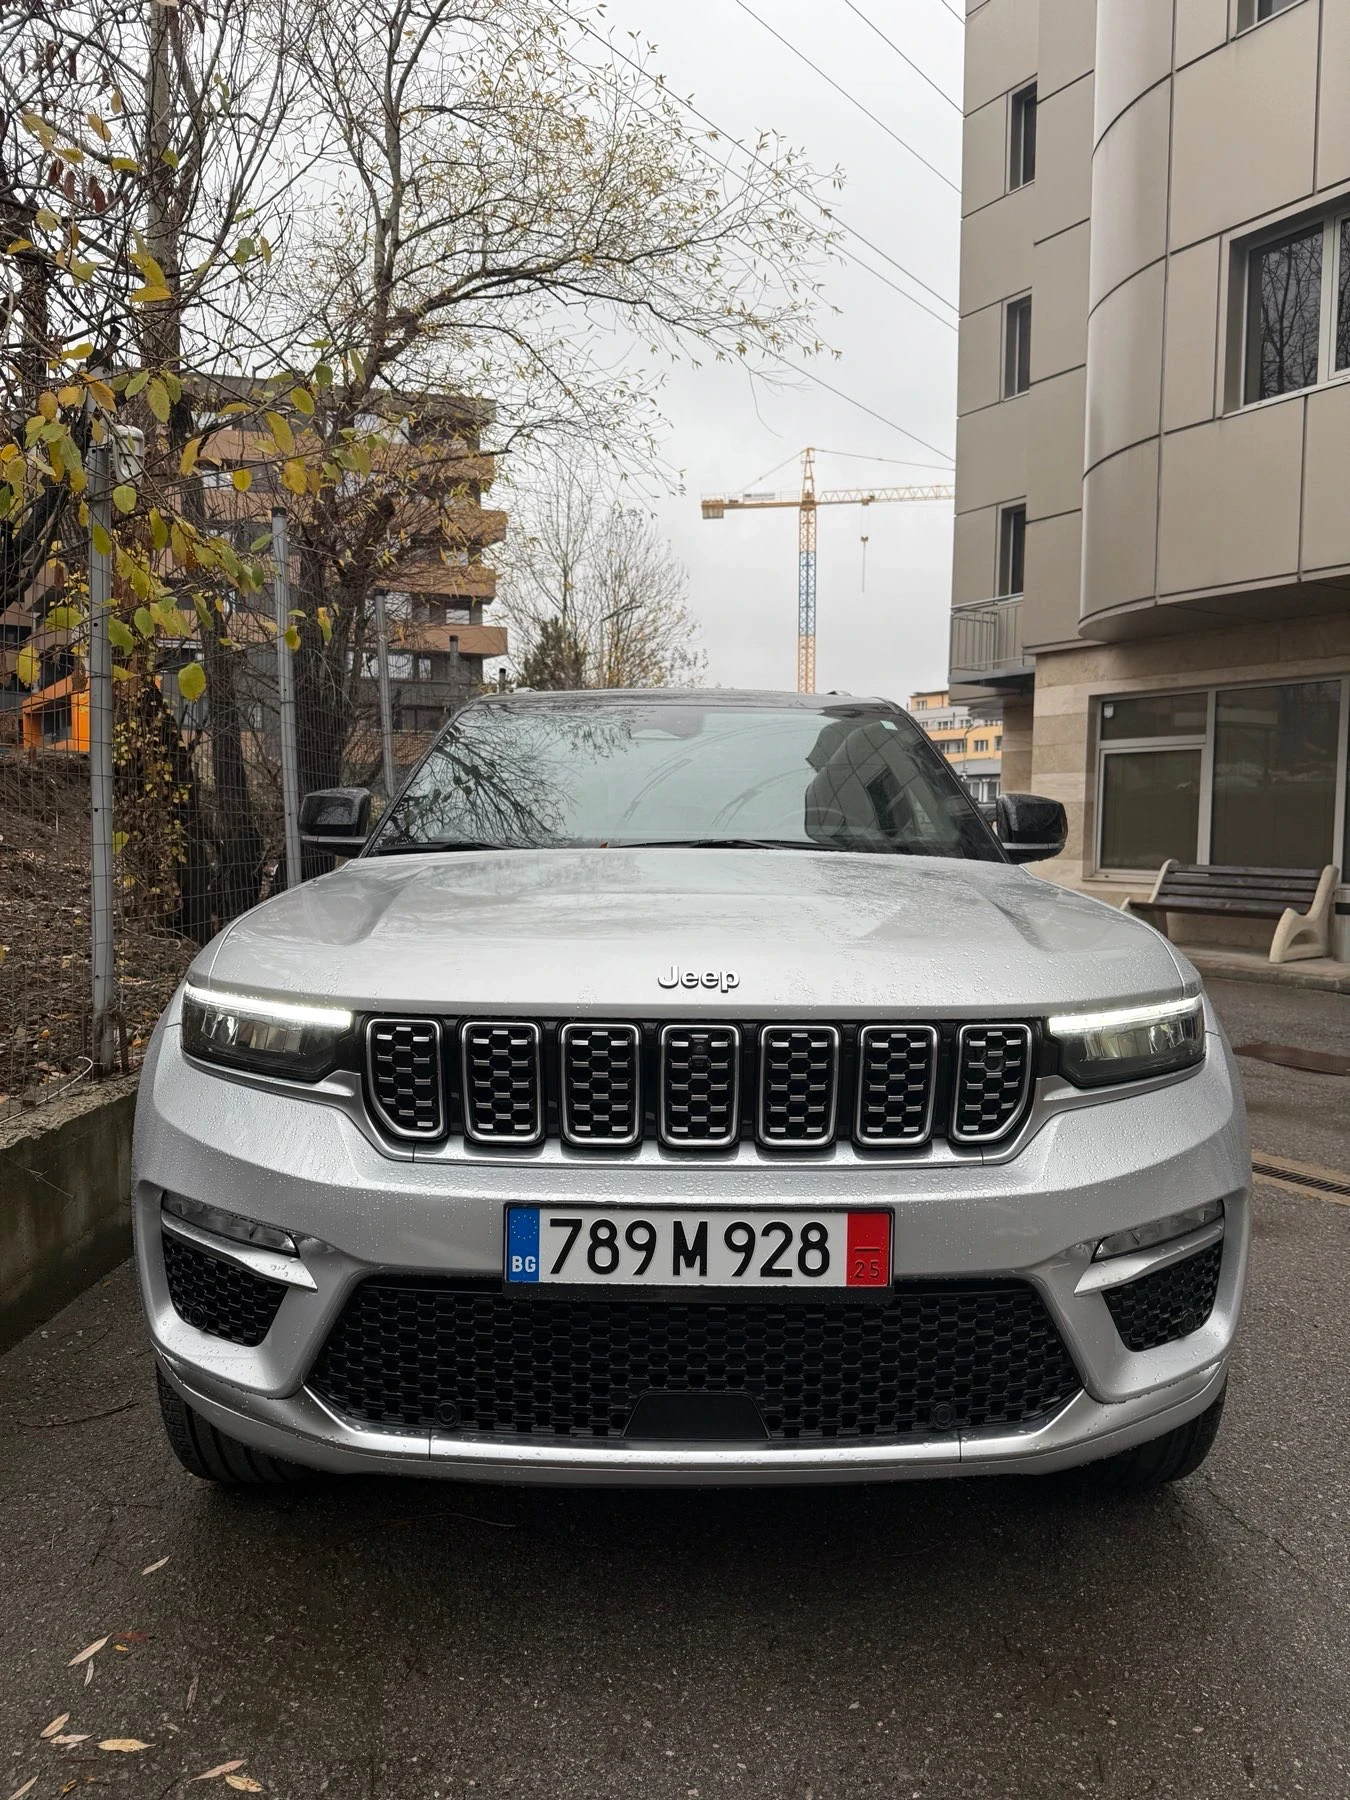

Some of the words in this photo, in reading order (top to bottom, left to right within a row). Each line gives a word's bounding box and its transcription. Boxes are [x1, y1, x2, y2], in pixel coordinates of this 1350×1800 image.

[657, 965, 740, 993] Jeep
[549, 1218, 657, 1276] 789
[673, 1220, 708, 1276] M
[724, 1221, 830, 1277] 928
[512, 1255, 536, 1272] BG
[854, 1260, 880, 1278] 25
